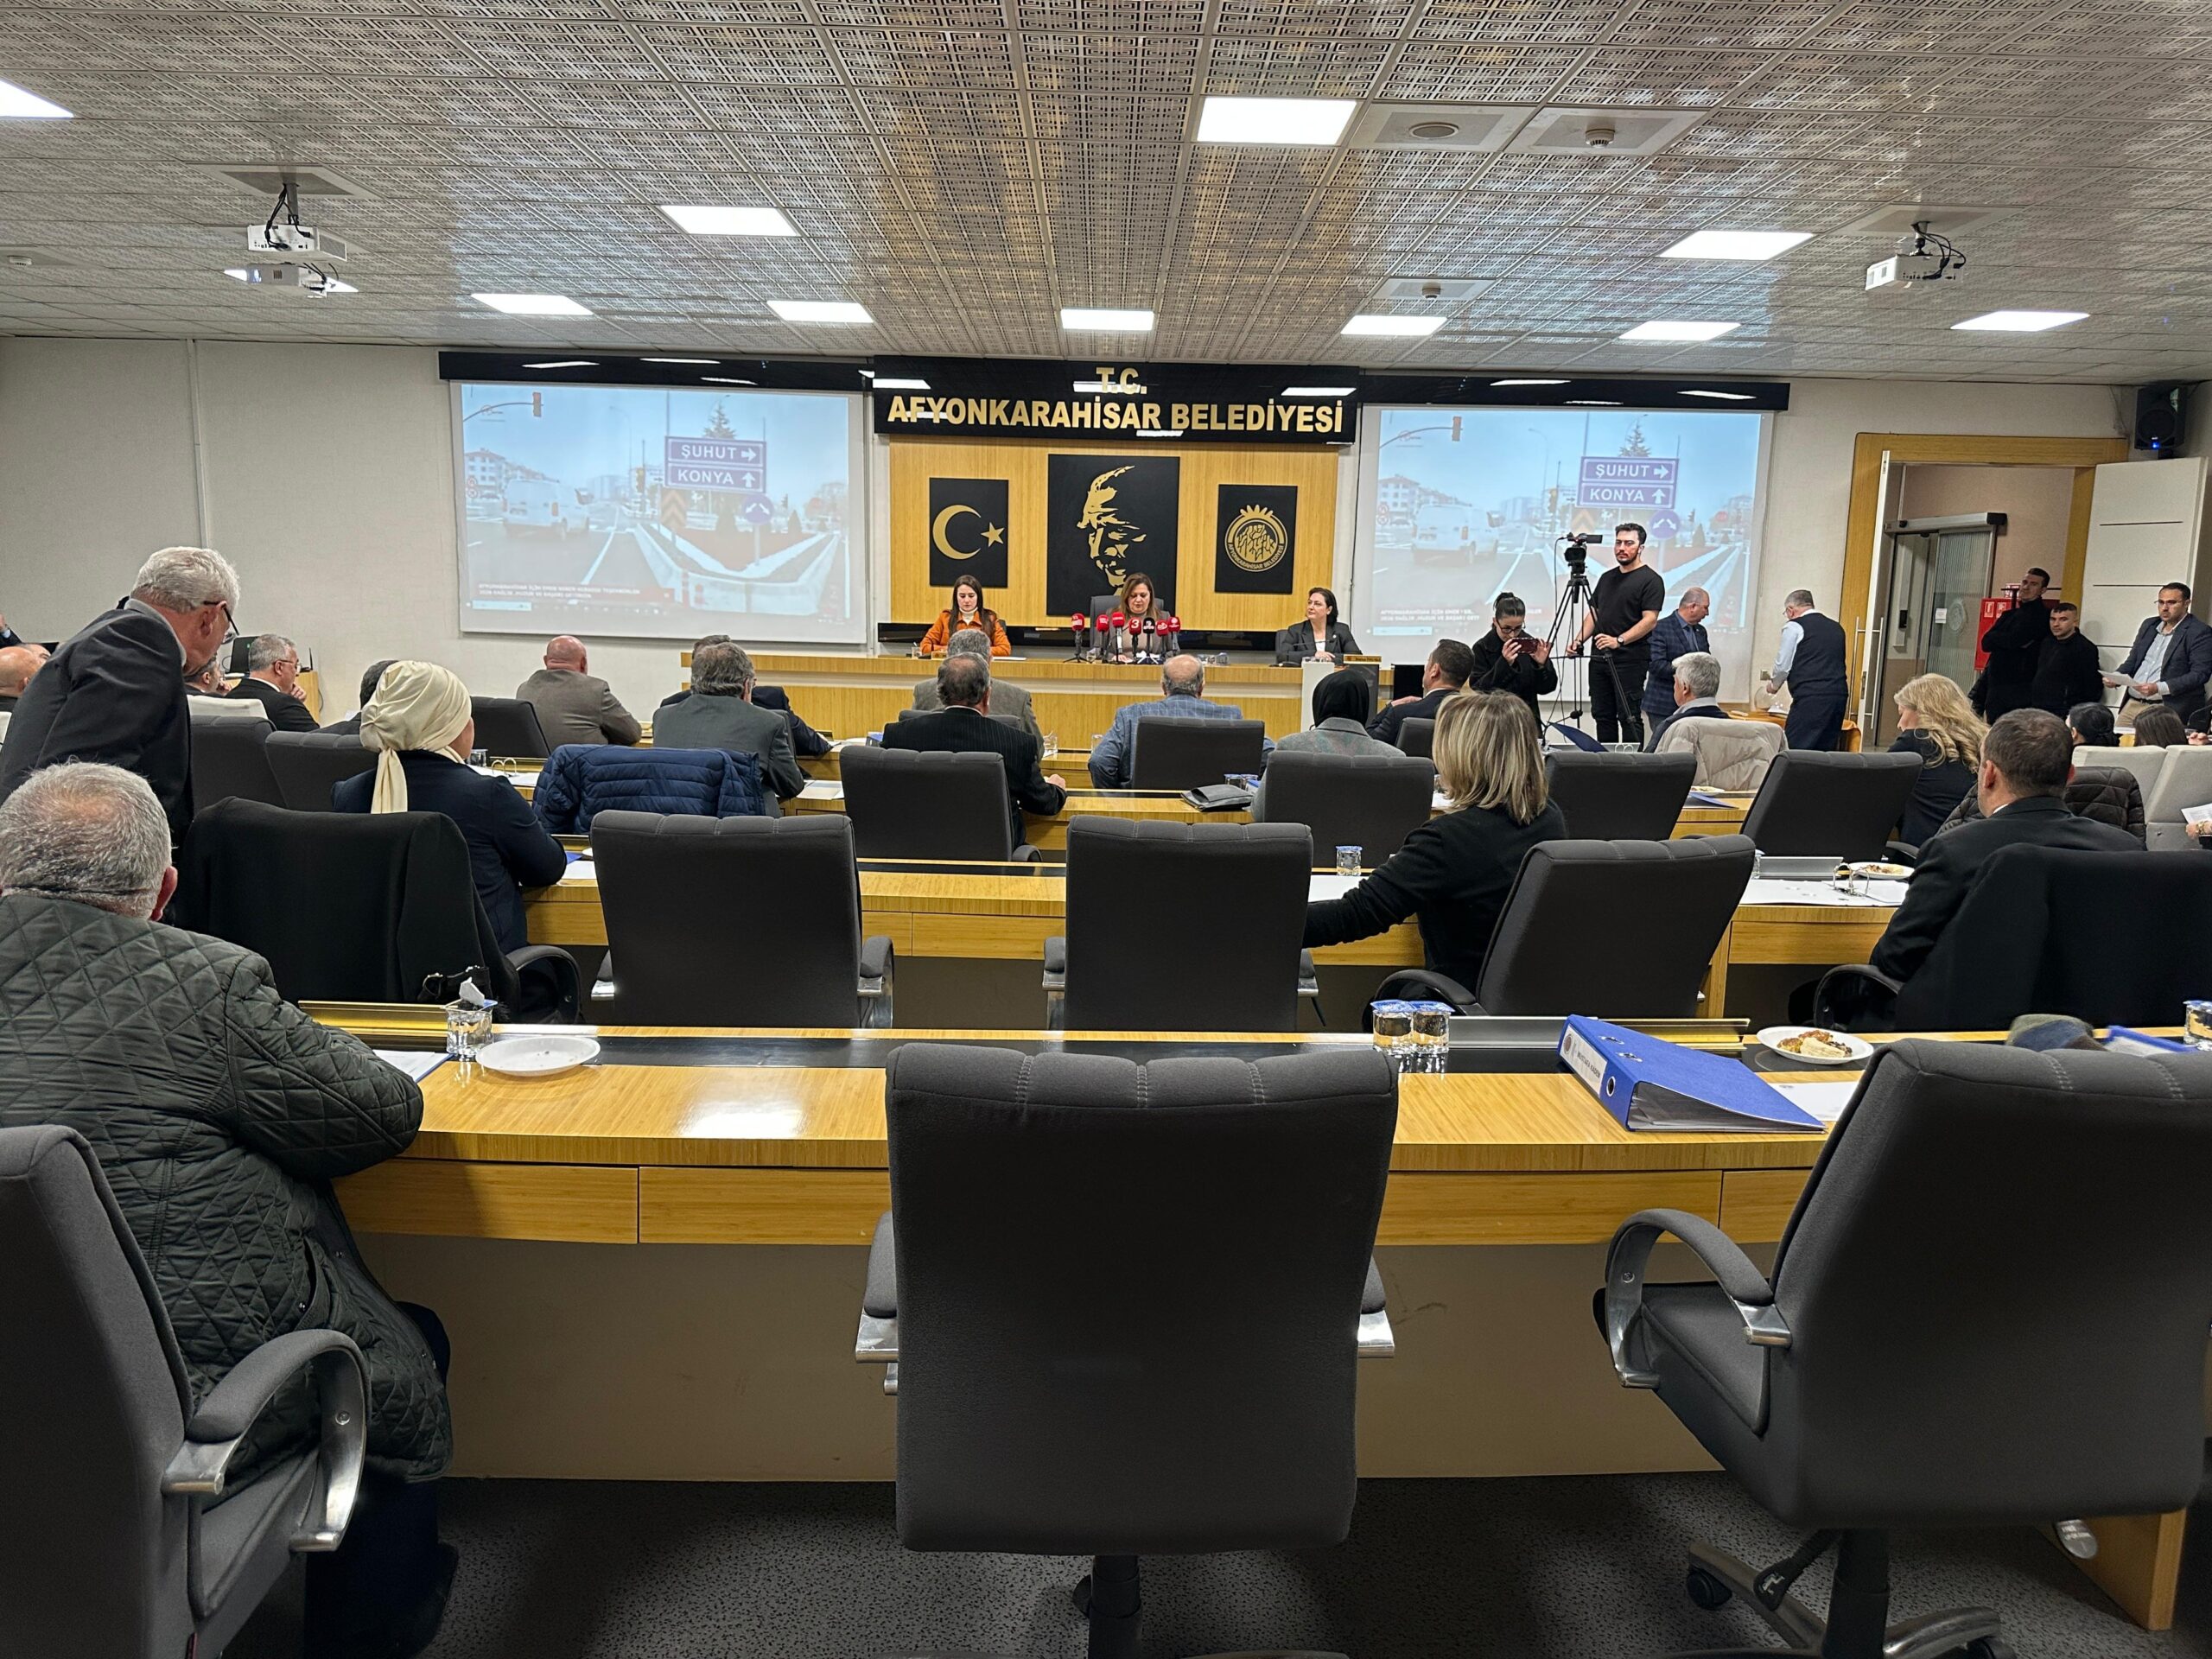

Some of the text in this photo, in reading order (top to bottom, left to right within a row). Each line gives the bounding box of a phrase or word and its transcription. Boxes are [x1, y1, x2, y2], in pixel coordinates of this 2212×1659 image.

[1096, 366, 1147, 395] T.C.
[887, 395, 1343, 433] AFYONKARAHİSAR BELEDİYESİ
[681, 444, 737, 460] ŞUHUT
[677, 469, 734, 485] KONYA
[1595, 463, 1650, 479] ŞUHUT
[1590, 488, 1645, 502] KONYA
[1131, 619, 1140, 629] 3
